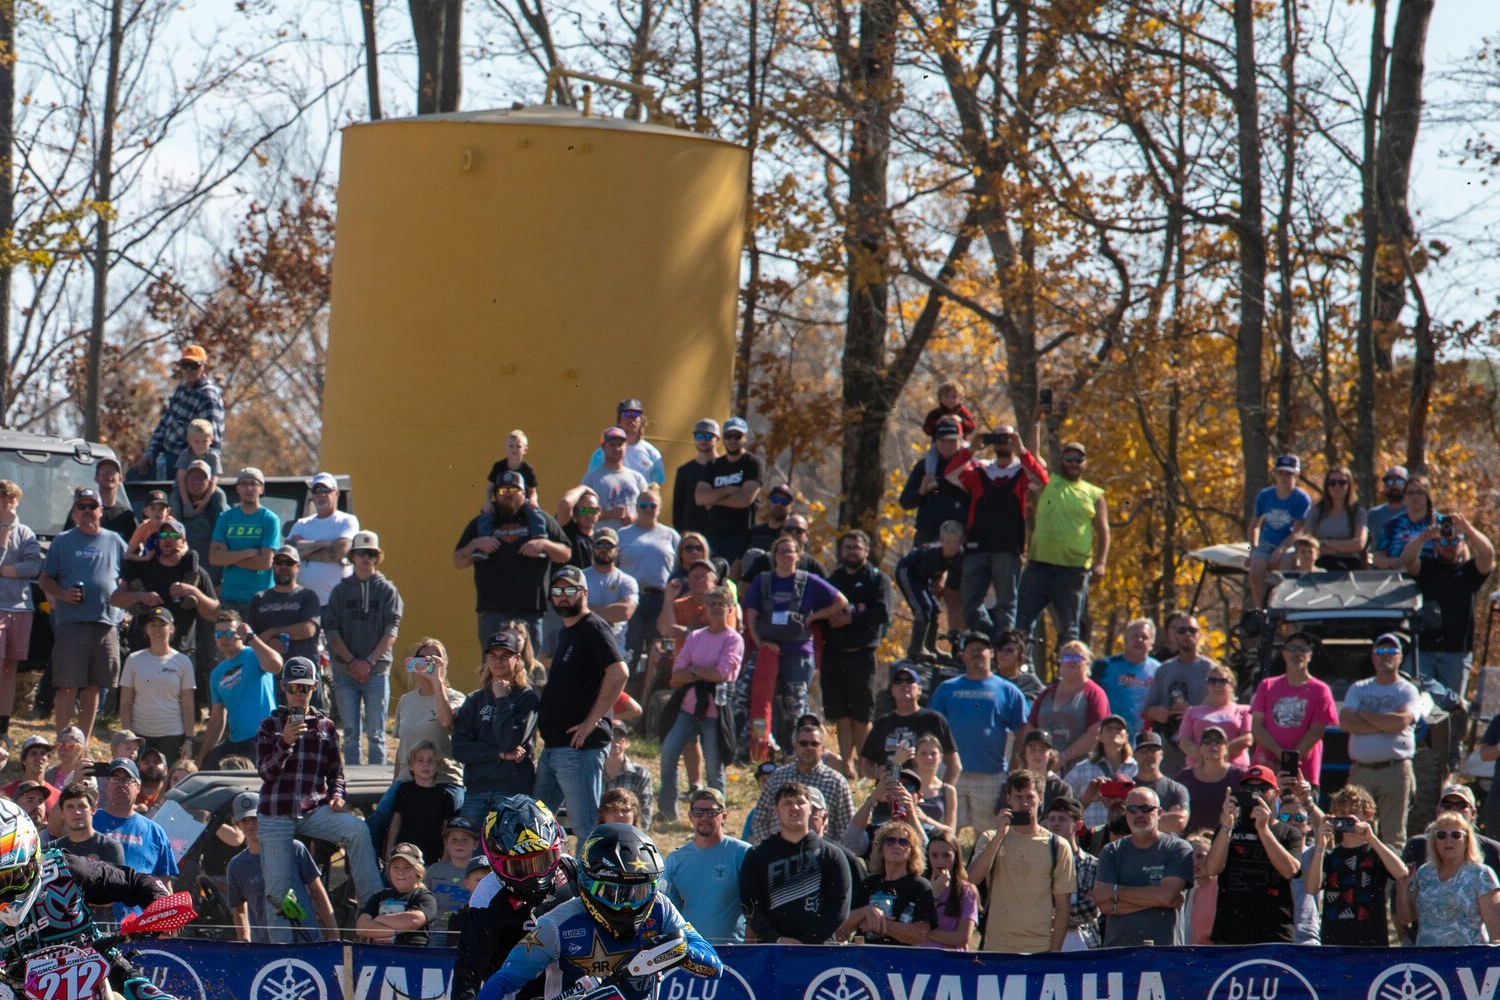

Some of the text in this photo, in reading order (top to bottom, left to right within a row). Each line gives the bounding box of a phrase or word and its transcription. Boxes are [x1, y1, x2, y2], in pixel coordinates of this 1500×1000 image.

[227, 527, 253, 536] FOX
[139, 909, 178, 926] ACERBIS
[1228, 976, 1279, 1000] bLU
